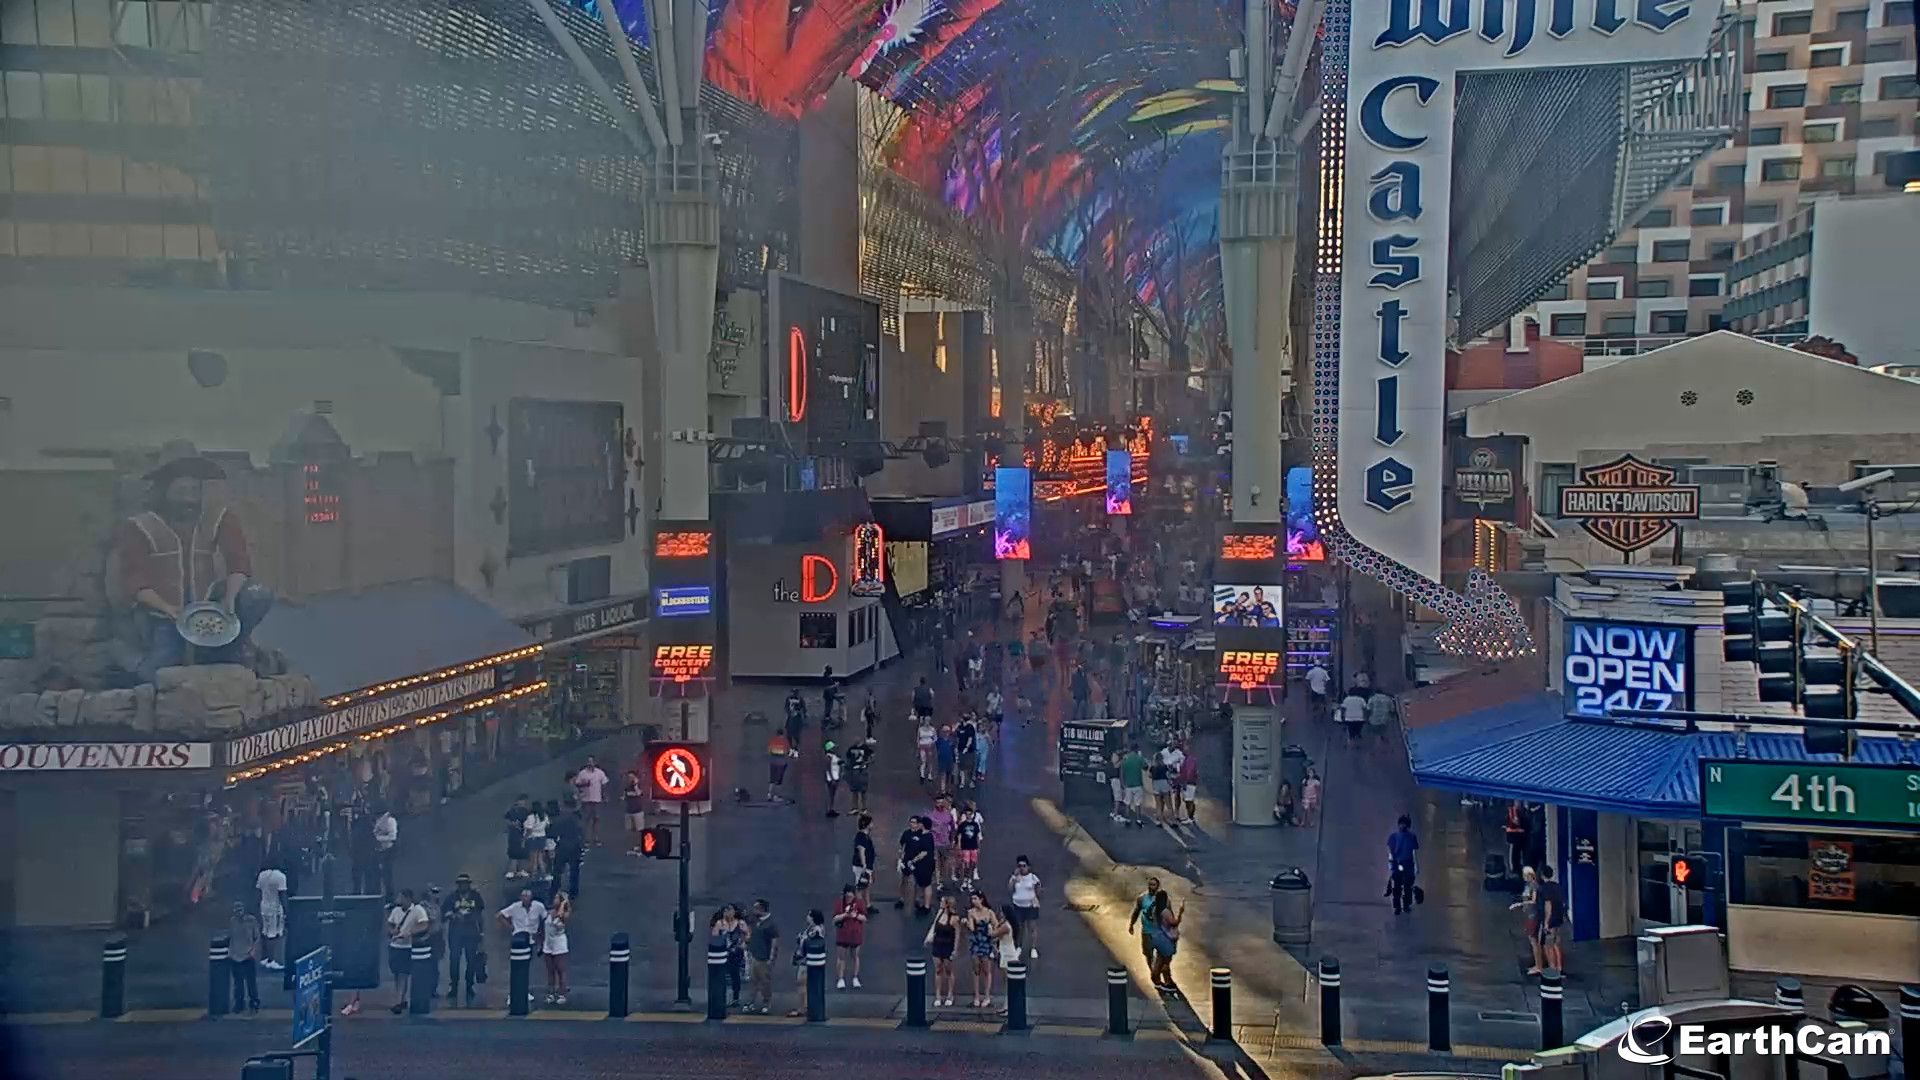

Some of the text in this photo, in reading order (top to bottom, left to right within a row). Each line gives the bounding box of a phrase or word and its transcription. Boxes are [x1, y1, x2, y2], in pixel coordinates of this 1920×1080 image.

[1358, 75, 1440, 513] Castle
[790, 326, 807, 422] D
[1598, 466, 1662, 486] MOTOR
[1568, 492, 1691, 512] HARLEY-DAVIDSON
[1598, 519, 1662, 543] CYCLES
[774, 555, 838, 602] the D
[656, 645, 713, 659] FREE
[1574, 625, 1676, 660] NOW
[654, 659, 711, 667] CONCERT
[1220, 665, 1277, 674] CONCERT
[1222, 651, 1279, 666] FREE
[663, 667, 687, 675] AUG
[1229, 673, 1253, 681] AUG
[1565, 655, 1685, 692] OPEN
[1576, 686, 1673, 715] 24/7
[232, 722, 298, 764] TOBACCO
[1710, 767, 1722, 783] N
[1771, 774, 1856, 814] 4th
